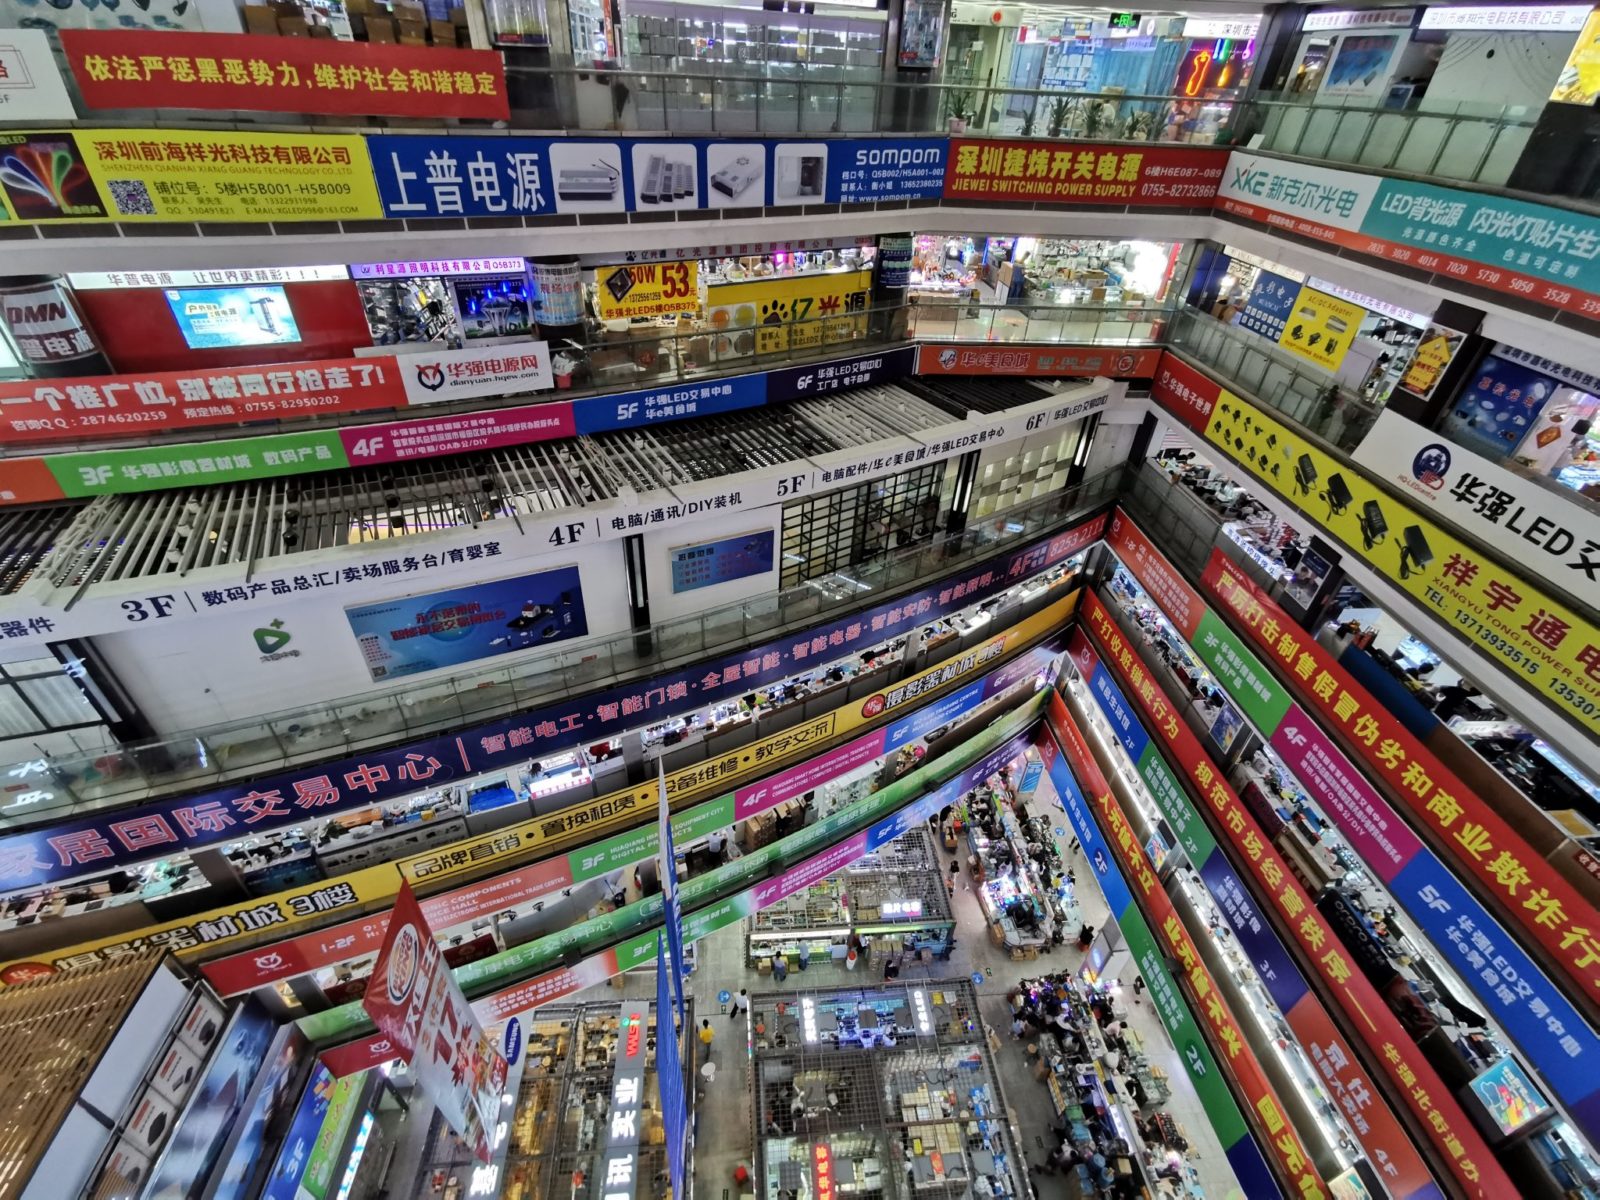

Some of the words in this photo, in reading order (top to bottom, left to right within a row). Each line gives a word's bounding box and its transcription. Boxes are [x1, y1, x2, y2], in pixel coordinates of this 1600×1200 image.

[84, 54, 497, 96] 依法严惩黑恶势力，维护社会和谐稳定
[96, 140, 352, 166] 深圳前海祥光科技有限公司
[955, 145, 1143, 183] 深圳捷炜开关电源
[389, 149, 546, 214] 上普电源
[952, 178, 989, 193] JIEWEI
[991, 179, 1052, 195] SWITCHING
[1054, 181, 1092, 195] POWER
[1094, 182, 1136, 198] SUPPLY
[1266, 174, 1359, 218] 新克尔光电
[1380, 192, 1467, 228] LED背光源
[1467, 206, 1600, 260] 闪光灯贴片生
[107, 271, 174, 287] 华普电源
[661, 260, 691, 299] 53
[1417, 254, 1439, 268] 4014
[1446, 261, 1468, 275] 7020
[1475, 268, 1500, 284] 5730
[1543, 287, 1572, 305] 3528
[446, 354, 539, 379] 华强电源网
[817, 358, 883, 379] 华强LED交易中心
[0, 363, 385, 415] 一个推广位，别被同行抢走了！
[449, 371, 540, 388] dianyuan.hqew.com
[796, 375, 814, 391] 6F
[644, 384, 732, 408] 华强LED交易中心
[1170, 378, 1212, 416] 华强电子世界
[617, 402, 639, 421] 5F
[1026, 412, 1046, 432] 6F
[353, 437, 384, 457] 4F
[78, 465, 113, 486] 3F
[262, 444, 333, 466] 数码产品
[777, 474, 806, 497] 5F
[548, 521, 586, 547] 4F
[611, 490, 743, 532] 电脑/通讯/DIY装机
[121, 594, 175, 622] 3F
[201, 540, 503, 608] 数码产品总汇/卖场服务台/育婴室
[0, 616, 56, 640] 器件
[1432, 575, 1486, 617] XIANGYU
[1484, 612, 1521, 642] TONG
[1522, 638, 1573, 678] POWER
[1203, 631, 1219, 649] 3F
[1091, 605, 1180, 740] 严打收赃销赃行为
[892, 726, 910, 742] 5F
[1125, 735, 1136, 751] 2F
[1283, 725, 1307, 748] 4F
[1214, 569, 1600, 988] 严厉打击制售假冒伪劣和商业欺诈行
[742, 788, 769, 808] 4F
[876, 825, 894, 840] 5F
[1184, 836, 1198, 855] 2F
[581, 853, 605, 872] 3F
[1094, 853, 1108, 874] 2F
[288, 882, 360, 917] 3楼
[755, 885, 777, 902] 4F
[1099, 792, 1155, 897] 人无信不立
[1162, 914, 1243, 1060] 业无信不兴
[632, 941, 652, 959] 3F
[1259, 959, 1278, 982] 3F
[1417, 884, 1452, 914] 5F
[1456, 914, 1583, 1058] 华强LED交易中心
[506, 1022, 520, 1058] SAMSUNG
[1185, 1046, 1207, 1077] 2F
[1309, 1041, 1371, 1136] 电脑大卖场
[1374, 1147, 1400, 1178] 4F
[604, 1076, 639, 1200] 讯实业
